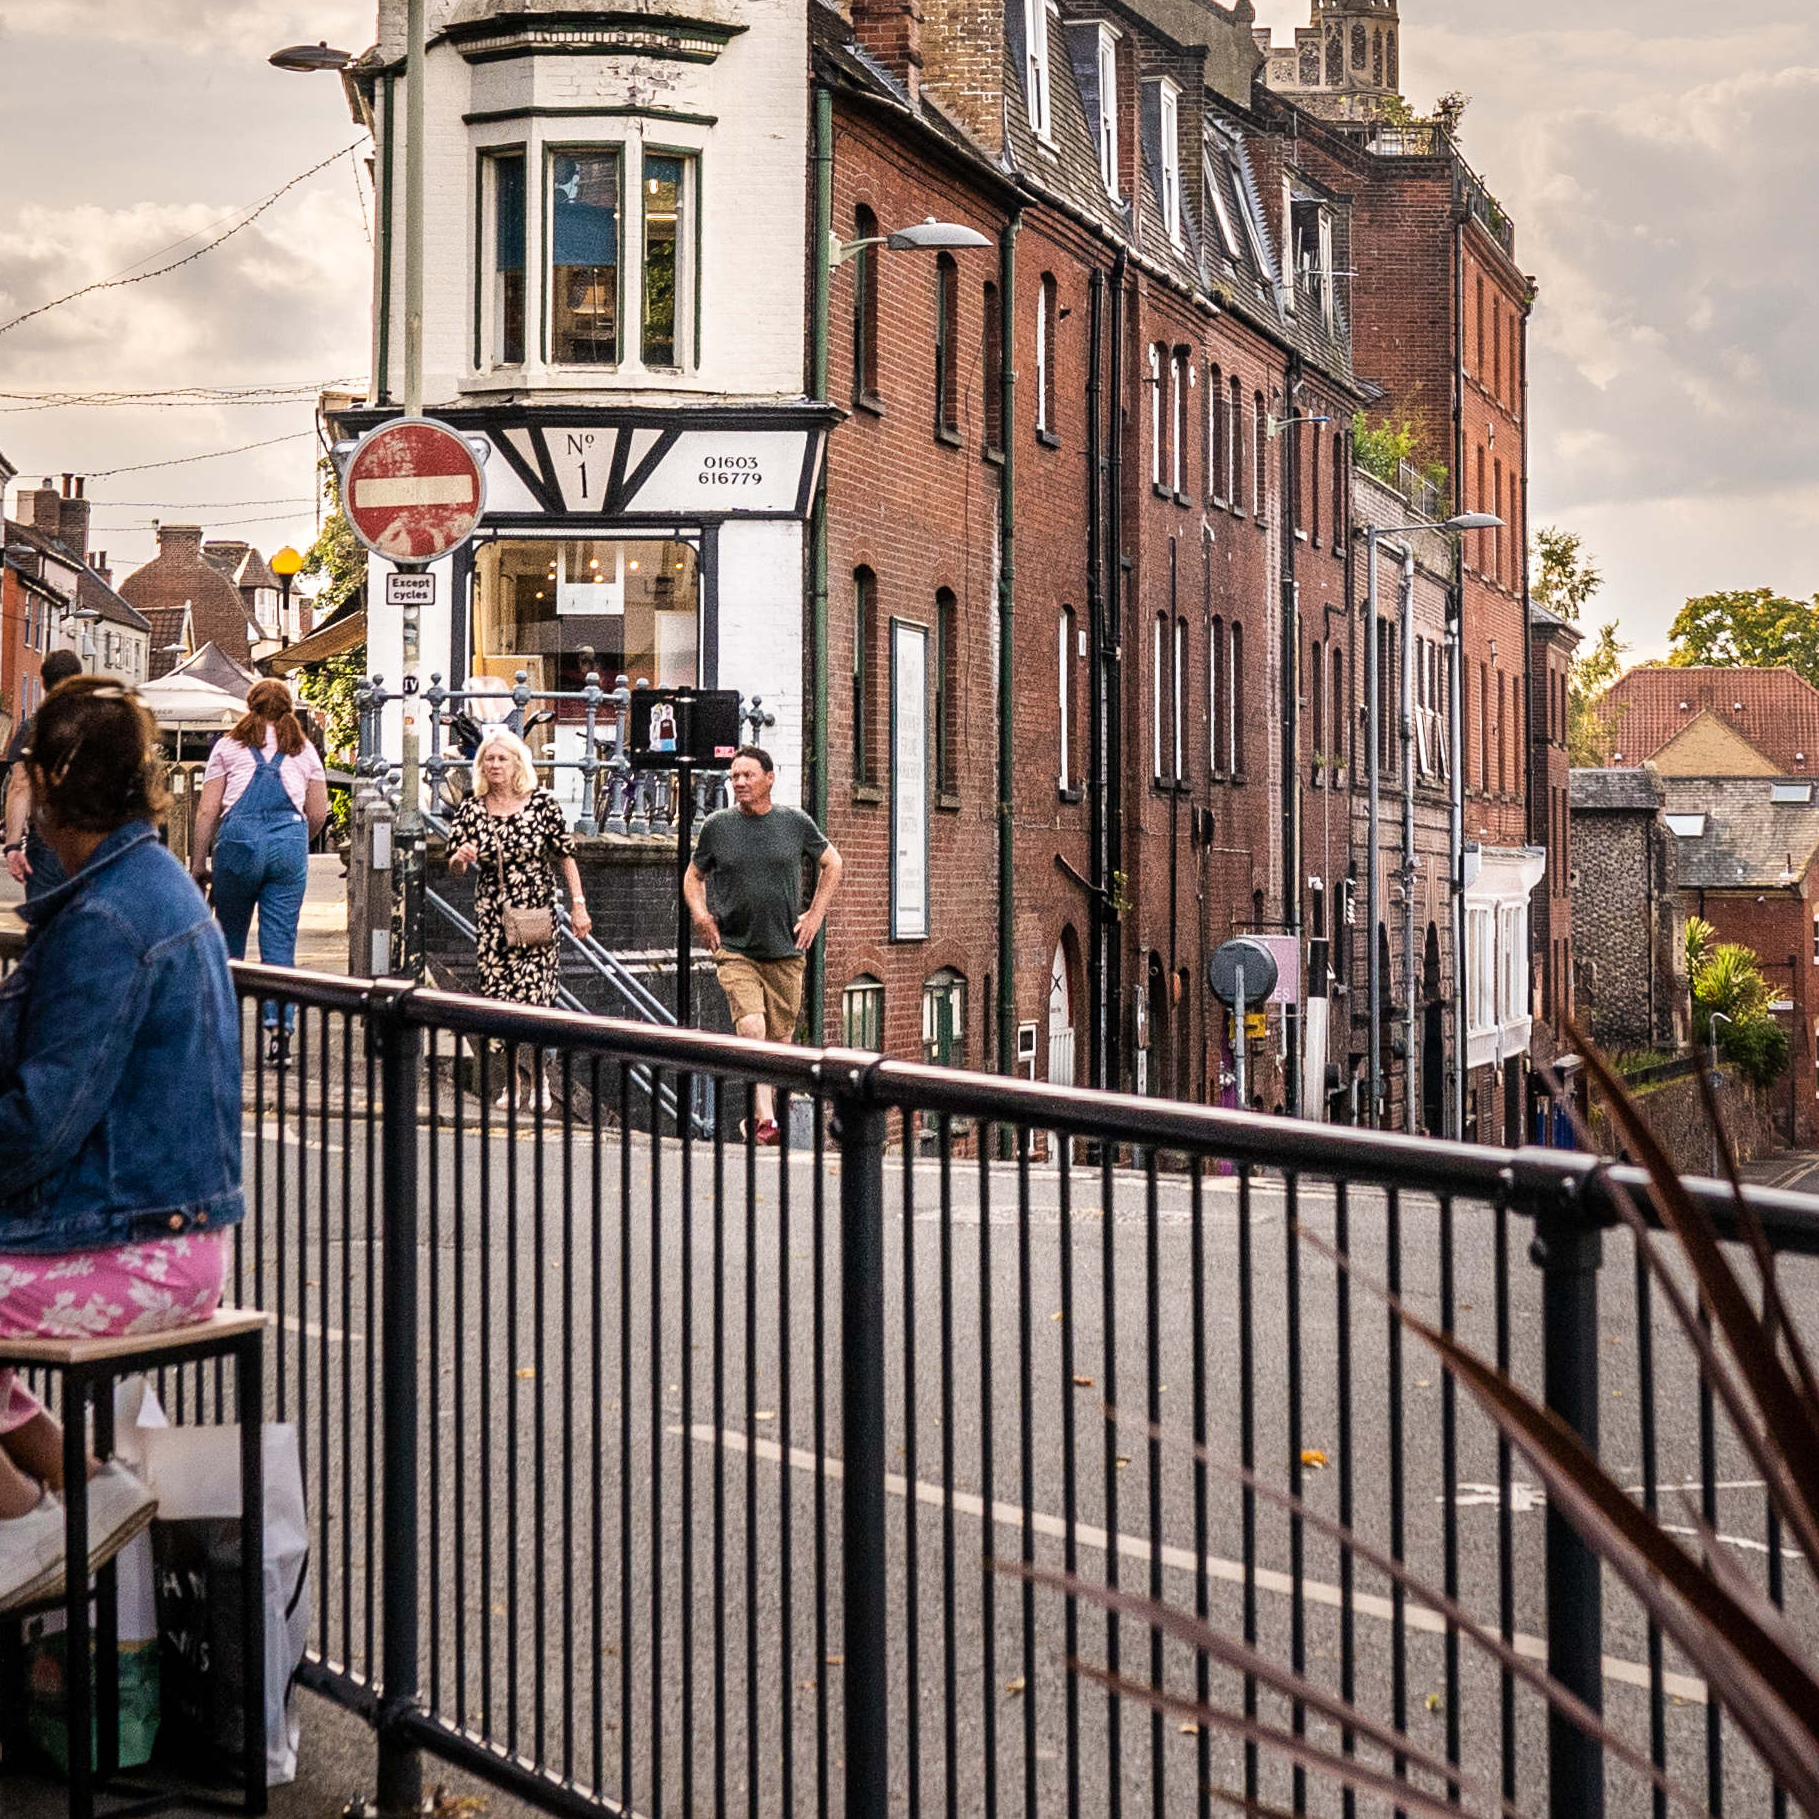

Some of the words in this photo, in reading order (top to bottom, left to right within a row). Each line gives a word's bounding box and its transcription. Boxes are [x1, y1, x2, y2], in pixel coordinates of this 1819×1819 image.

[704, 456, 759, 470] 01603
[698, 472, 763, 486] 616779
[392, 578, 430, 589] Except
[393, 590, 428, 601] cycles
